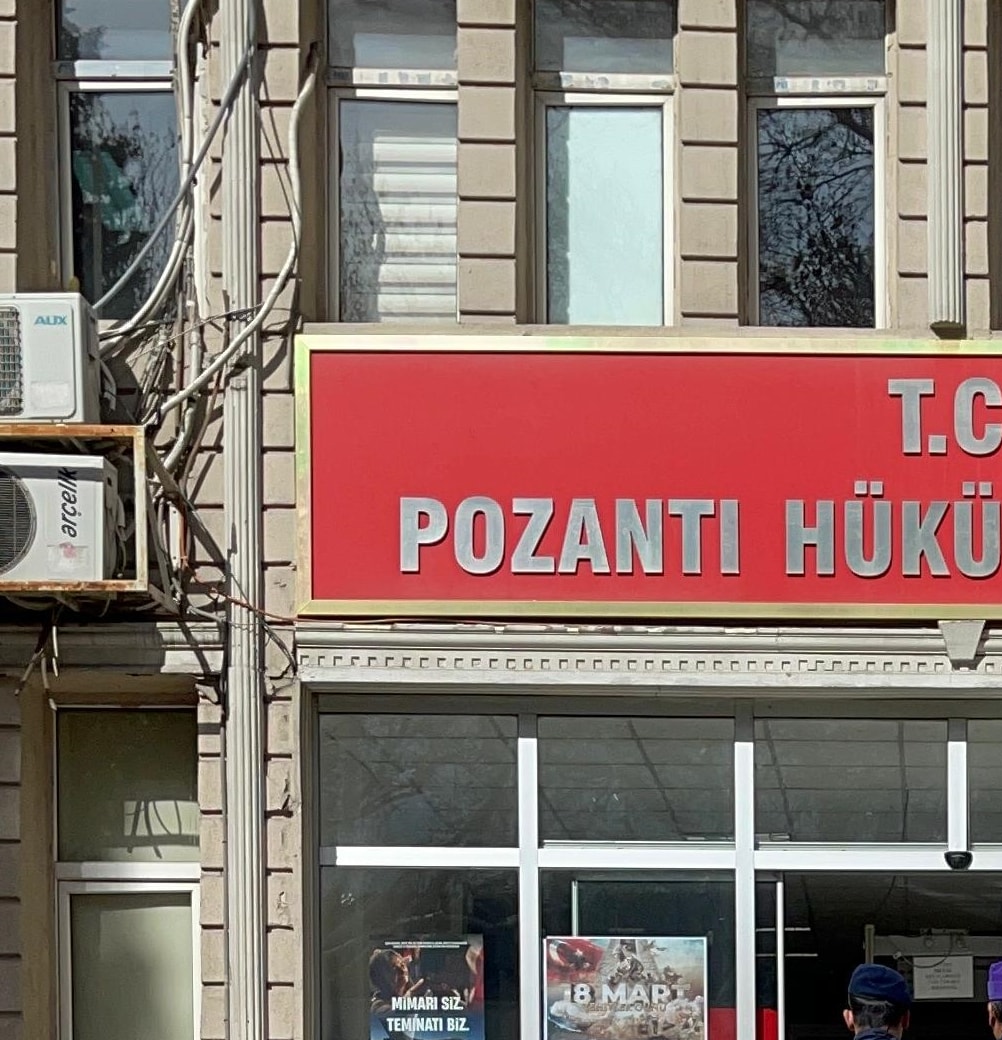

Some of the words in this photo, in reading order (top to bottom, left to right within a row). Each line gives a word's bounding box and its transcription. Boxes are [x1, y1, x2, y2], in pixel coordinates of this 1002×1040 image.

[33, 315, 67, 326] AUX
[58, 466, 81, 538] arçelik
[398, 495, 741, 577] POZANTI
[602, 983, 692, 1005] MART
